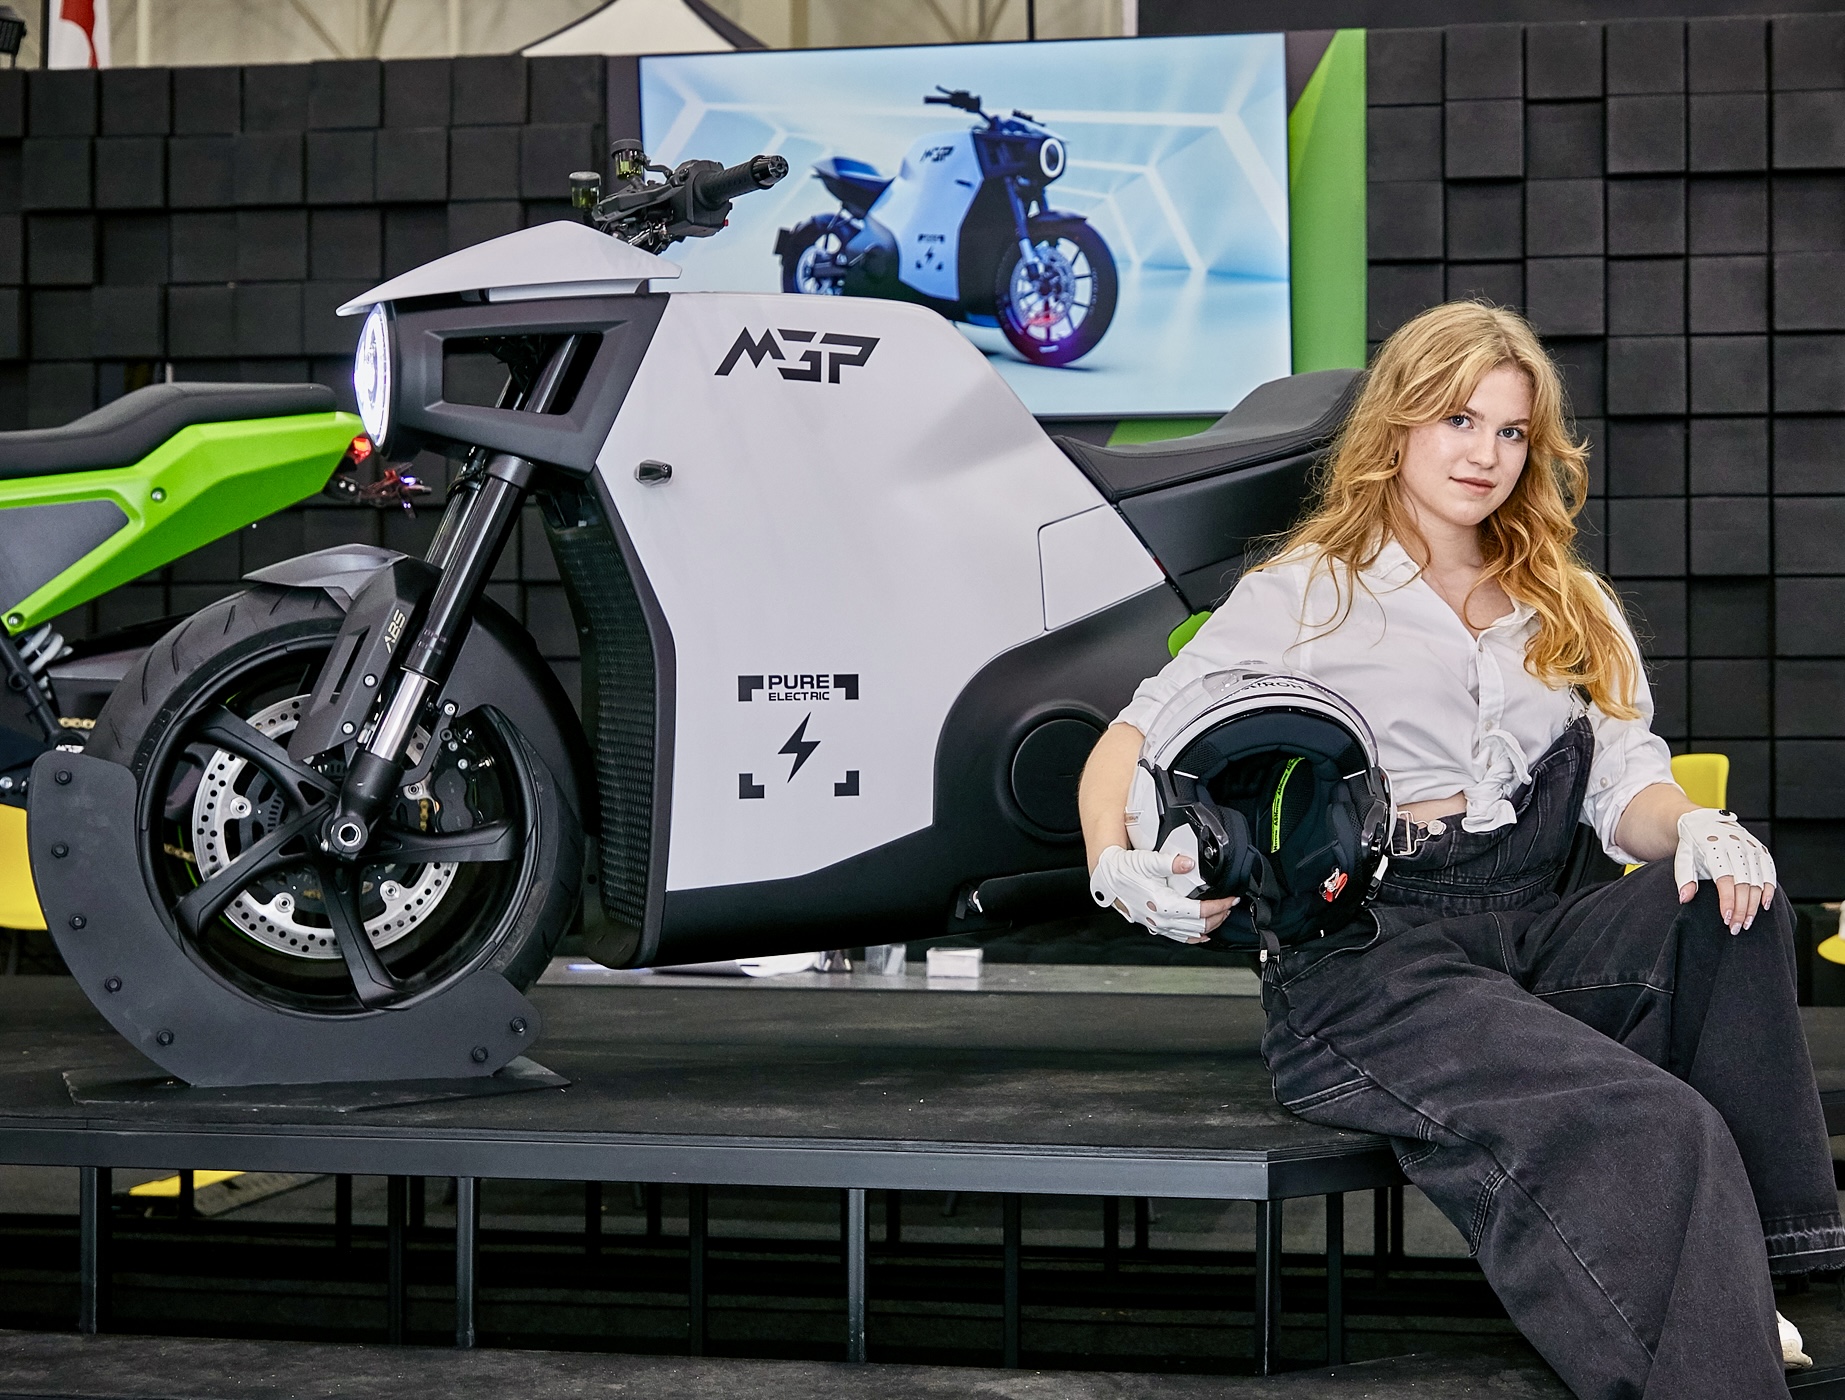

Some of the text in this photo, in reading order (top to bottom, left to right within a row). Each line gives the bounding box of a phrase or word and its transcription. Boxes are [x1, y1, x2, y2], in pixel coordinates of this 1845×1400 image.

[384, 609, 406, 654] ABS
[768, 674, 830, 690] PURE
[768, 691, 830, 701] ELECTRIC
